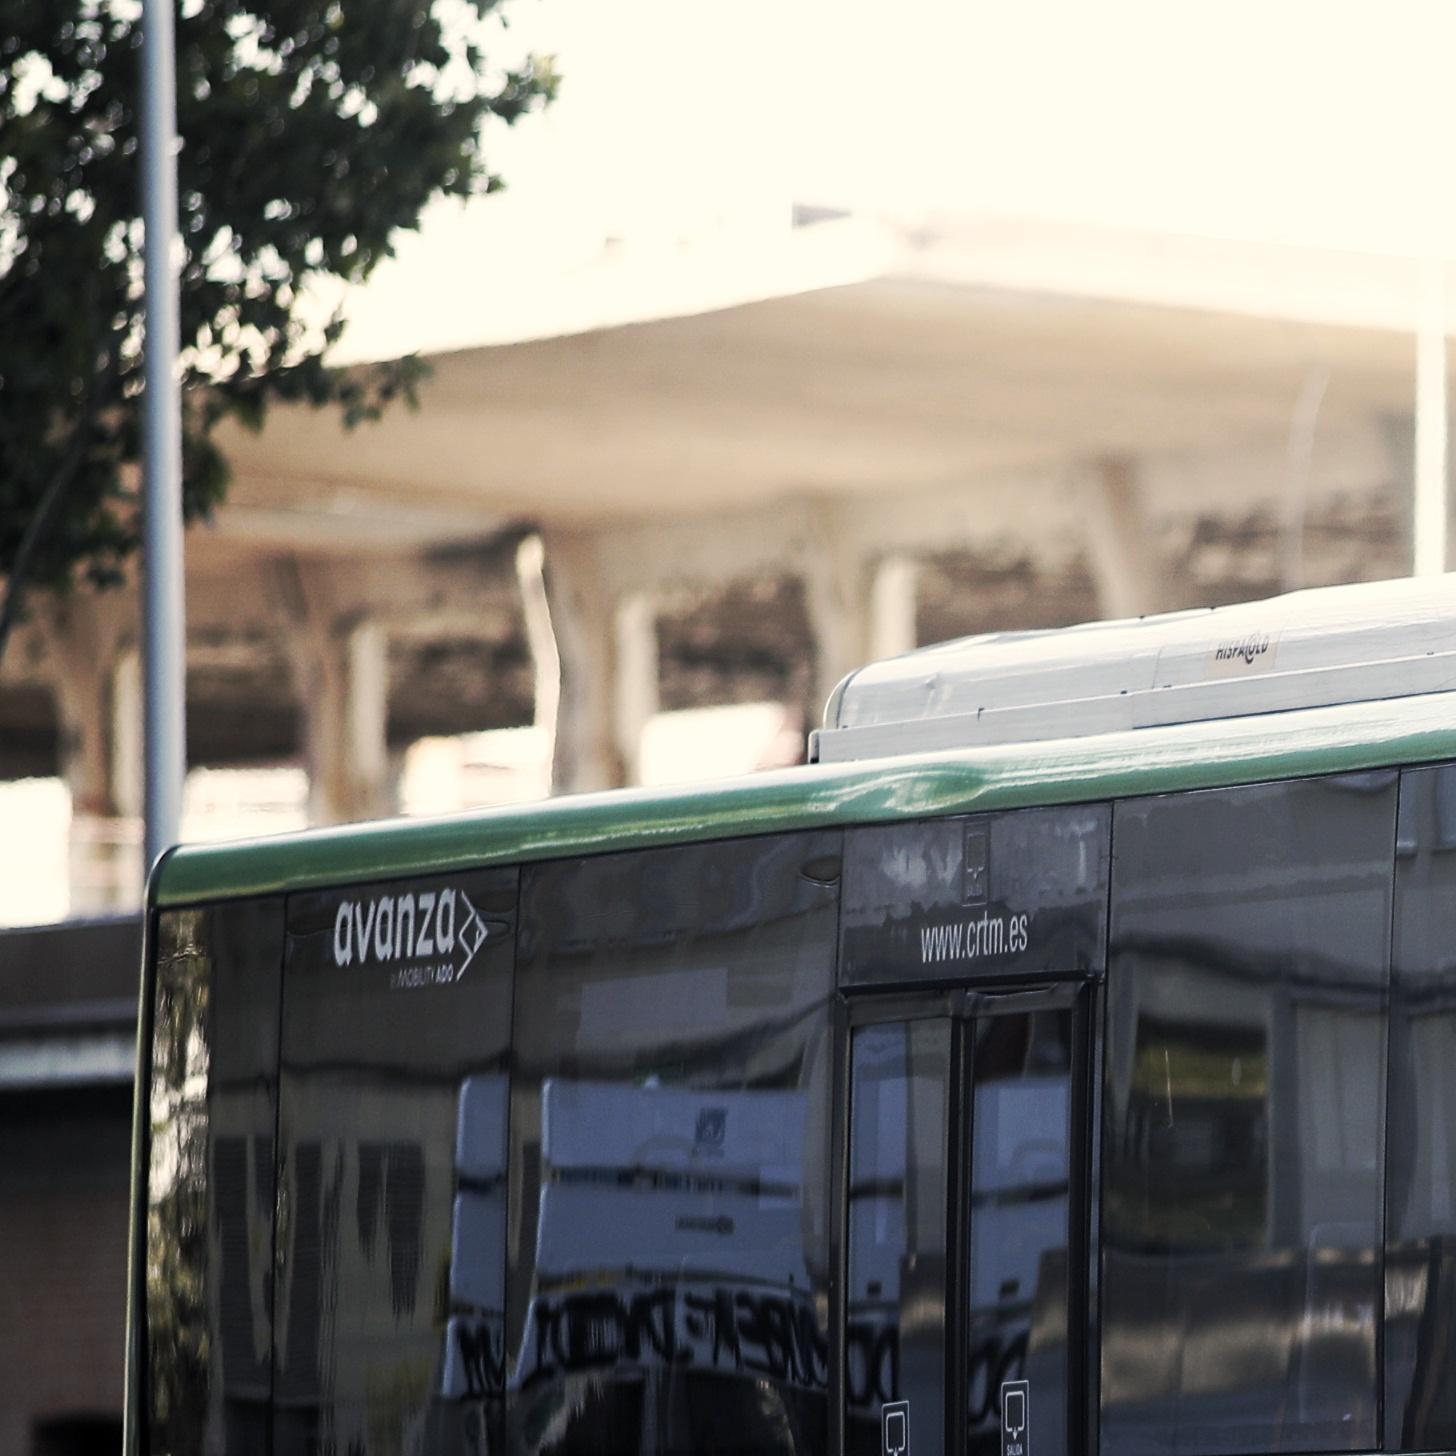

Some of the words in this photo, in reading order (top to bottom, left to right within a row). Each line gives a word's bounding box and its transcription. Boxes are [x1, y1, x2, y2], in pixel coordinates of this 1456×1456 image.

[334, 887, 457, 967] avanza
[921, 910, 1028, 964] www.crtm.es
[1006, 1444, 1023, 1456] SALIDA
